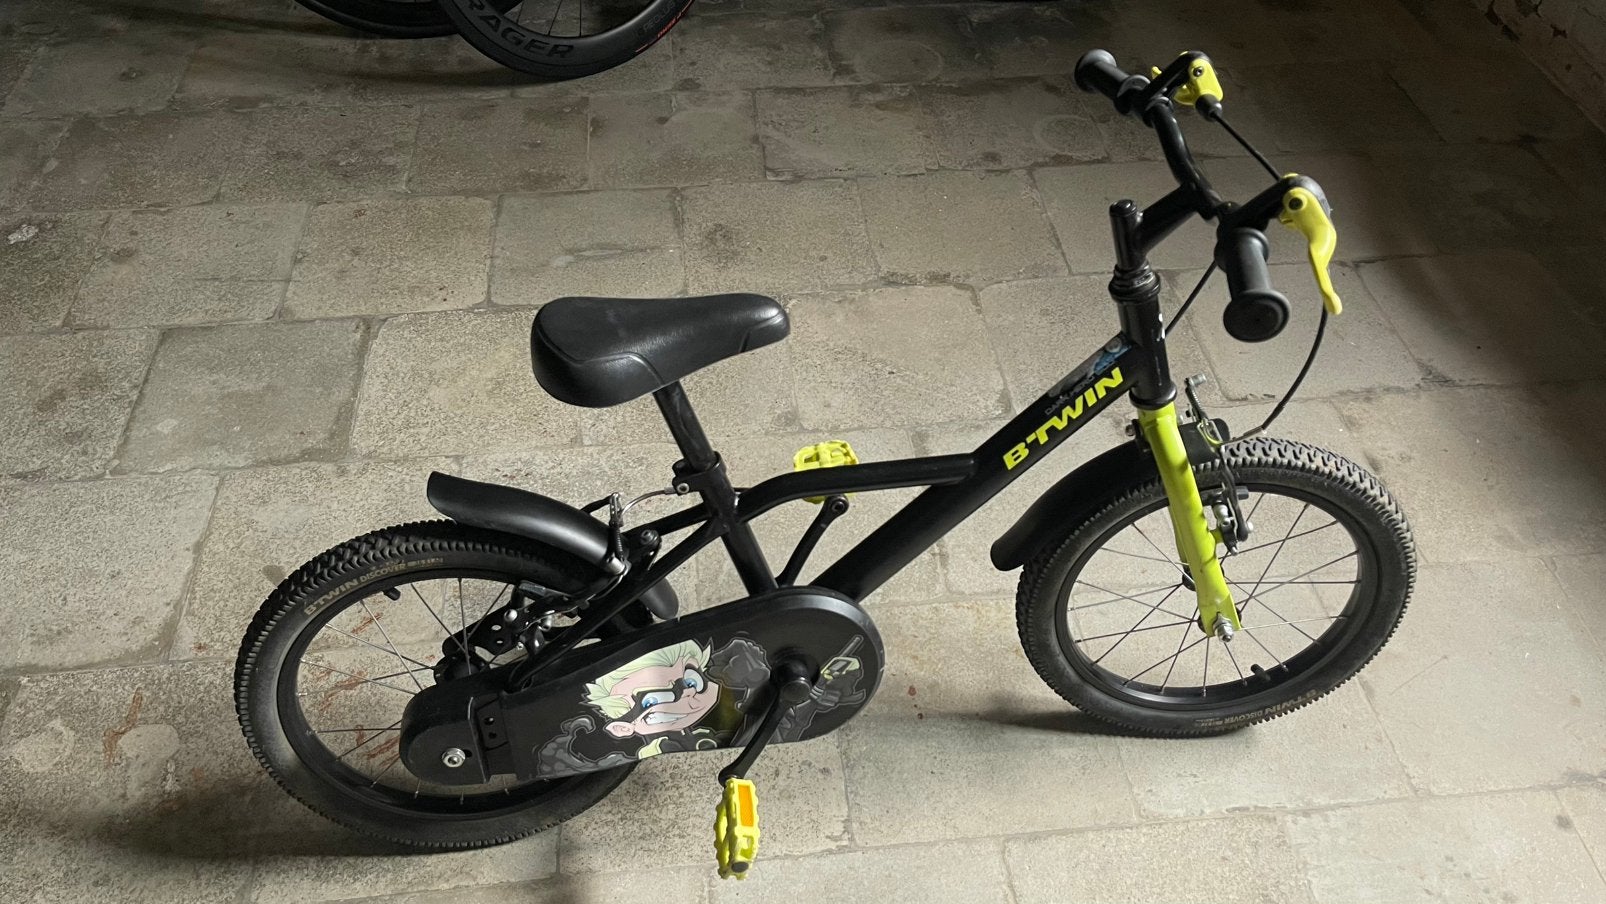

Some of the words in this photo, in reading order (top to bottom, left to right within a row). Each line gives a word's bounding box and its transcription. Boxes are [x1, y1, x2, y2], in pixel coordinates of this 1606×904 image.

[1003, 367, 1123, 470] B'TWIN
[360, 563, 406, 583] DISCOVER
[1224, 710, 1263, 724] DISCOVER
